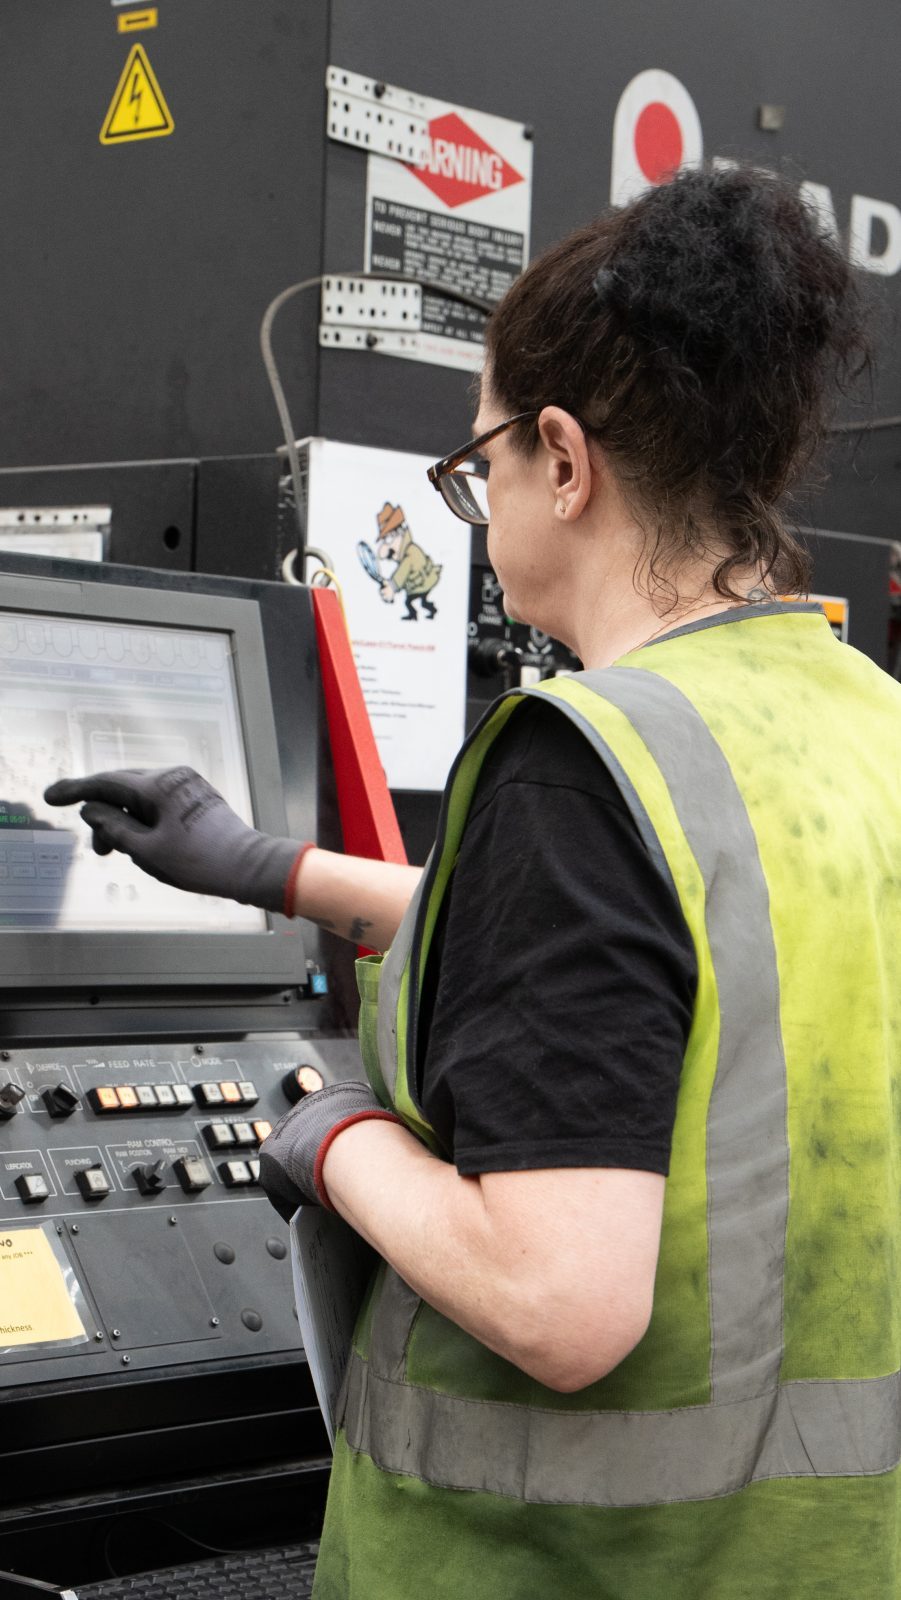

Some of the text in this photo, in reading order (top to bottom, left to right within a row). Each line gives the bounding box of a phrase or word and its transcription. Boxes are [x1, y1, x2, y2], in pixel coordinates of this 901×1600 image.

[415, 137, 503, 189] ARNING
[108, 1060, 130, 1069] FEED
[133, 1059, 156, 1068] RATE
[273, 1062, 298, 1071] START
[127, 1138, 175, 1149] RAM CONTROL
[0, 1324, 33, 1334] hickness
